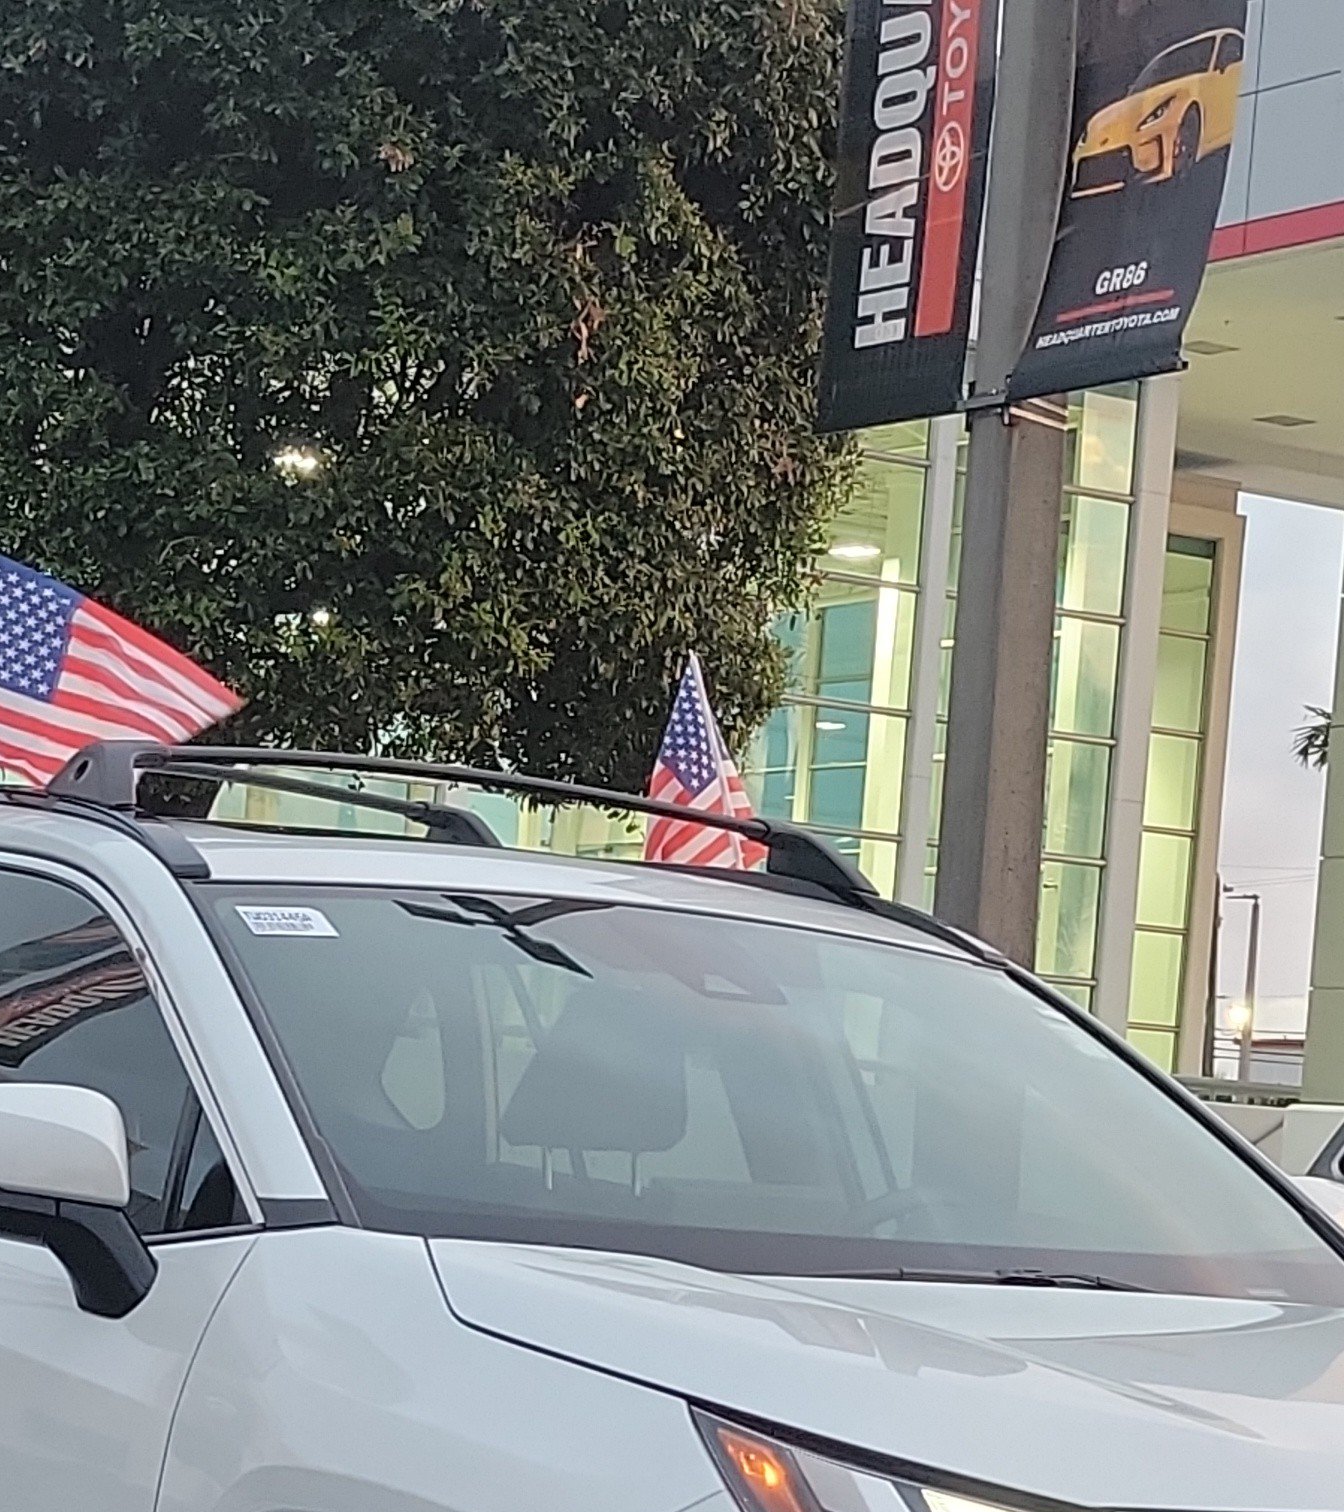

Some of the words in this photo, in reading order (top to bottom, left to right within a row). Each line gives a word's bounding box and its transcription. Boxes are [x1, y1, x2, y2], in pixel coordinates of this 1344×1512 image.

[854, 0, 937, 349] HEADQU
[1094, 260, 1148, 296] GR86
[1035, 306, 1181, 350] HEADQUARTERTOYOTA.COM
